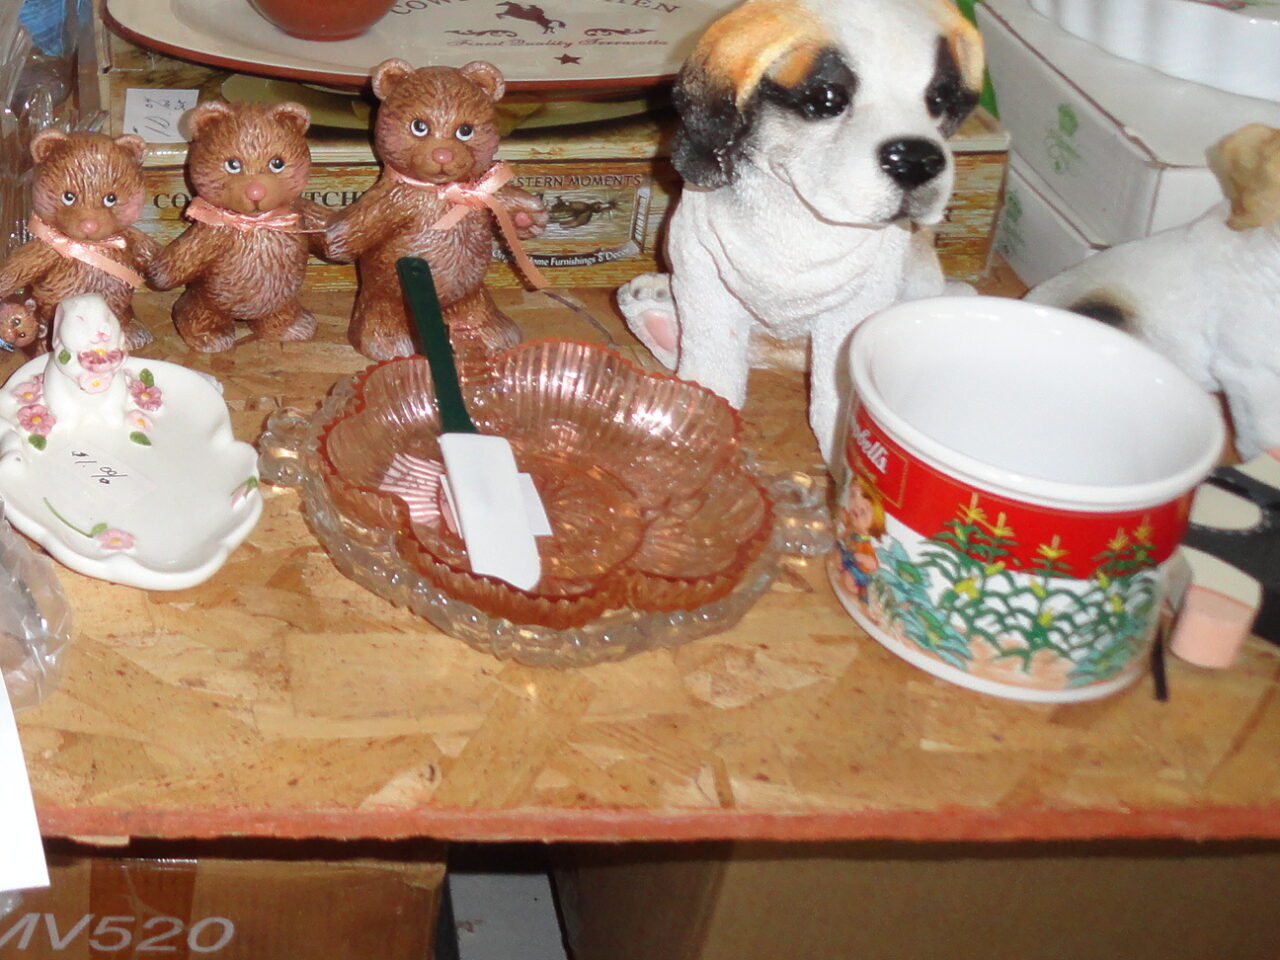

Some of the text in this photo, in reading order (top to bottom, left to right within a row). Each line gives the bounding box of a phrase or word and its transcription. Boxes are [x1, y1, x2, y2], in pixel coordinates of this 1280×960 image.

[511, 174, 642, 188] STERN MOMENTS
[550, 253, 597, 268] Furnishings
